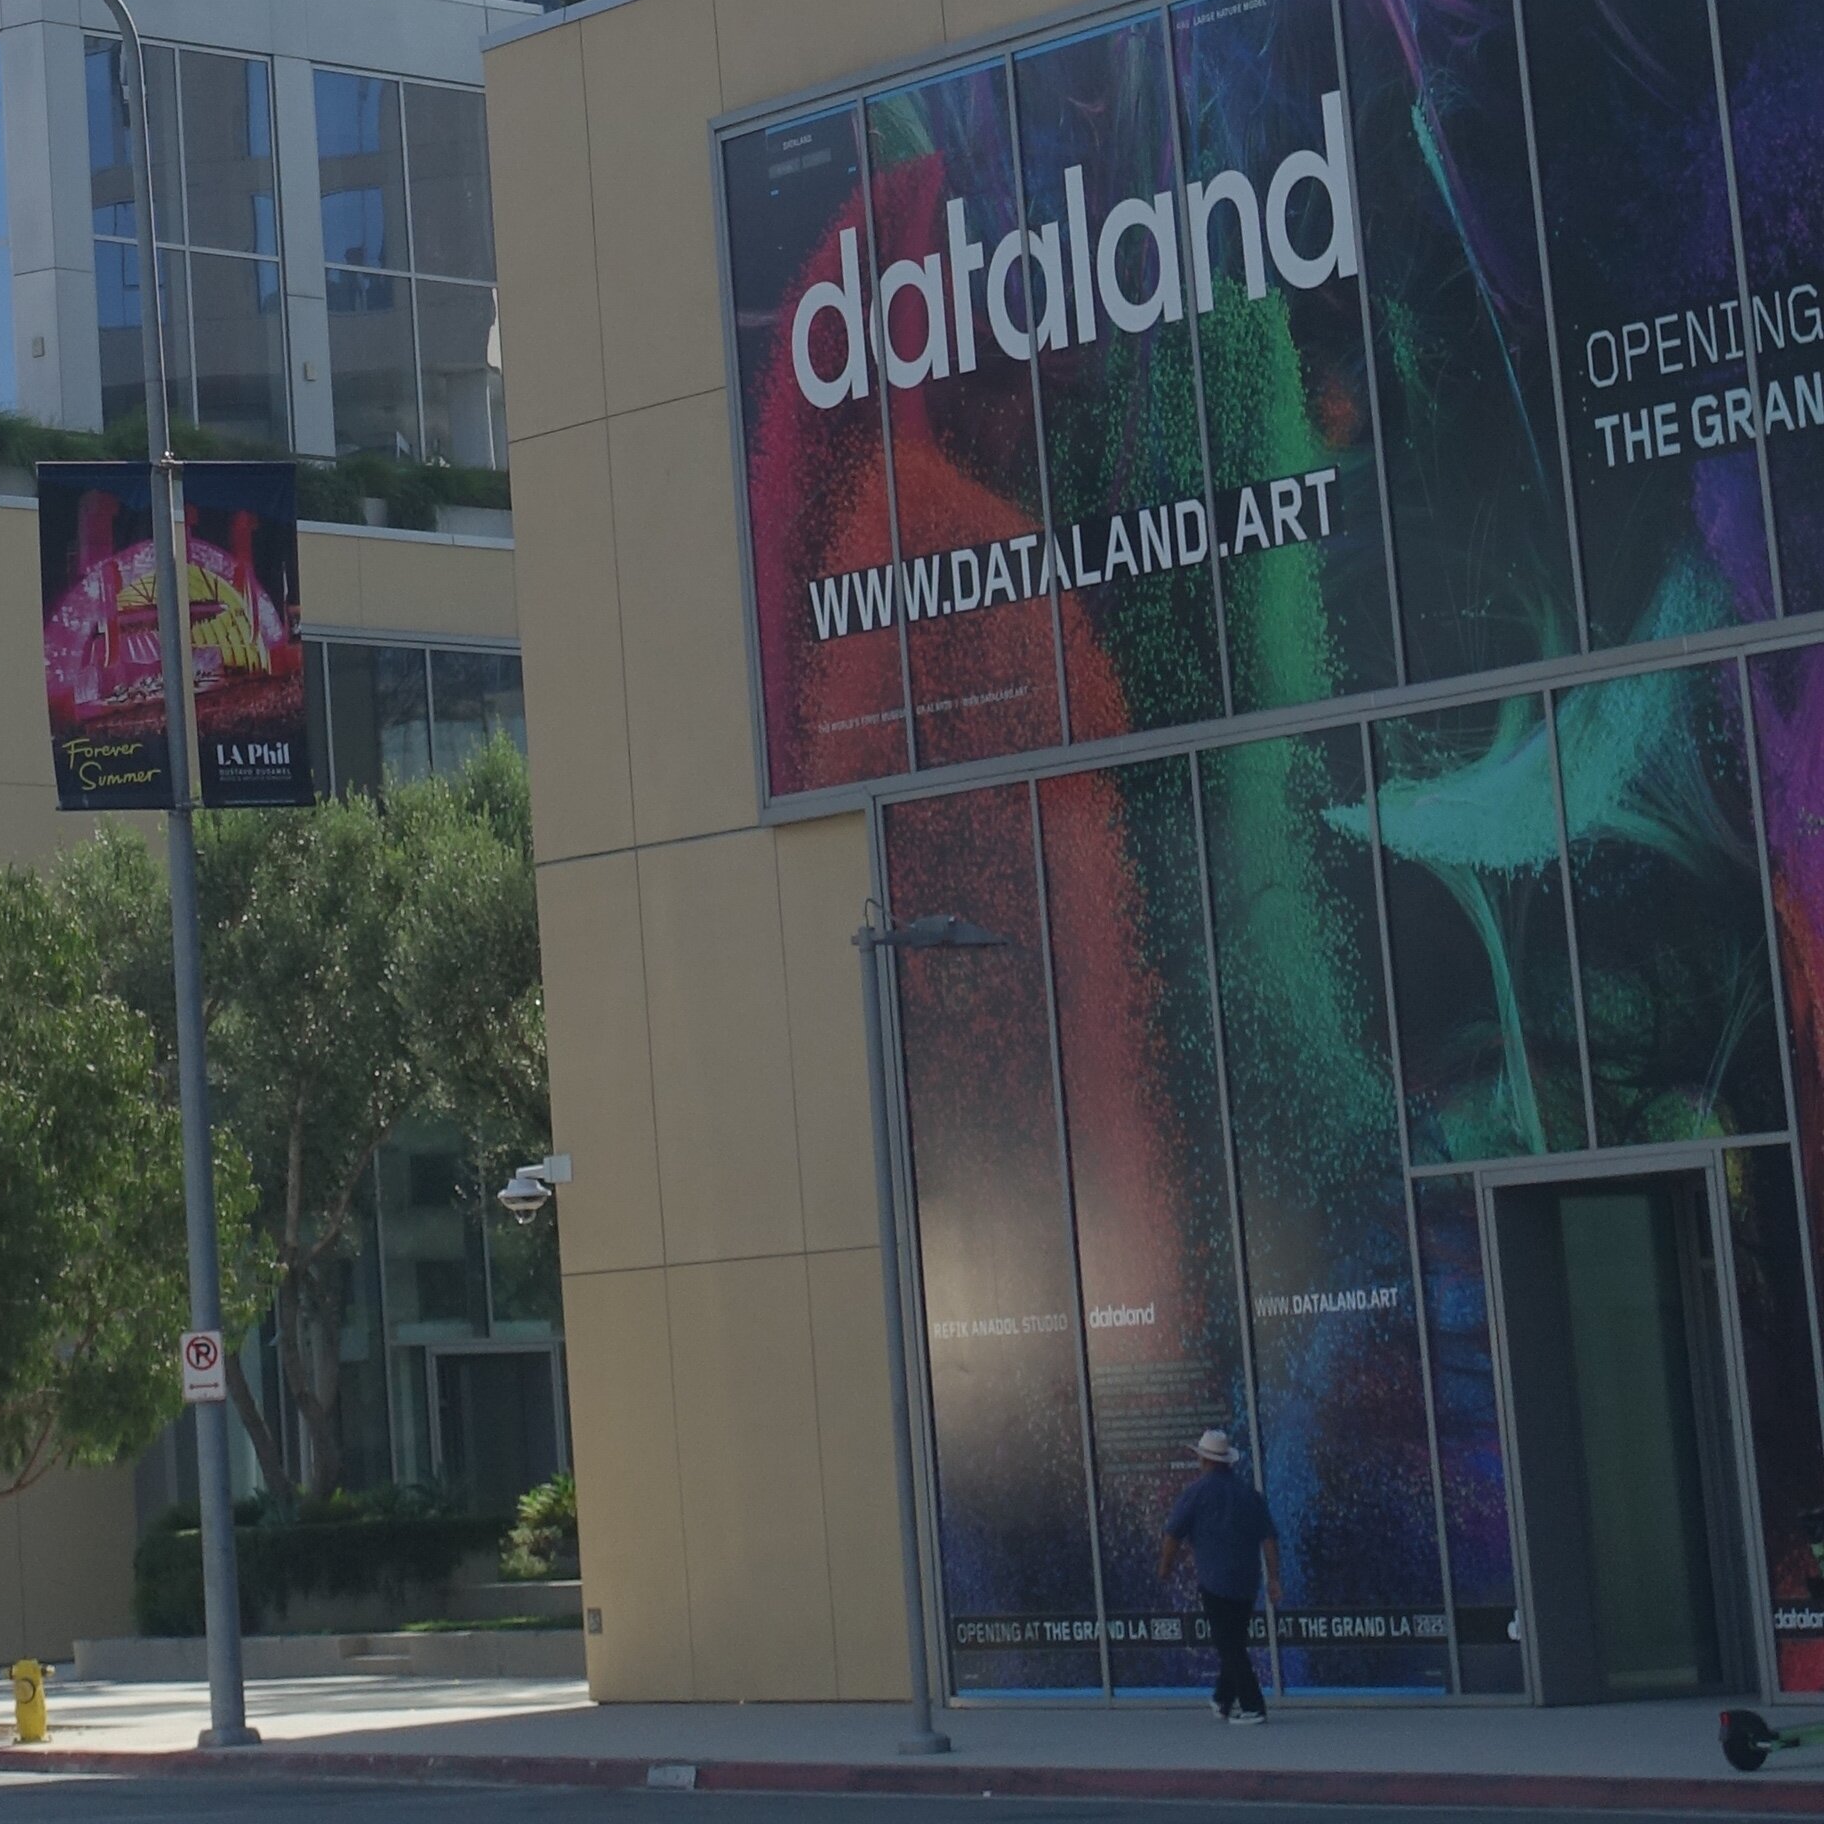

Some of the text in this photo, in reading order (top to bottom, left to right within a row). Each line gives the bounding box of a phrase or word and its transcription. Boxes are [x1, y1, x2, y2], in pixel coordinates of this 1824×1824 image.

[792, 90, 1358, 409] dataland
[1586, 284, 1824, 388] OPENING
[1594, 402, 1681, 468] THE
[808, 468, 1337, 641] WWW.DATALAND.ART
[62, 738, 142, 769] Forever
[216, 742, 290, 766] LA Phil
[79, 762, 161, 790] Summer
[934, 1313, 1069, 1339] REFIK ANADOL STUDIO
[1089, 1302, 1155, 1329] dataland
[956, 1621, 1021, 1643] OPENING
[1024, 1622, 1040, 1641] AT
[1043, 1621, 1070, 1641] THE
[1072, 1620, 1125, 1641] GRAND
[1128, 1619, 1149, 1640] LA
[1277, 1618, 1294, 1637] AT
[1298, 1617, 1328, 1637] THE
[1331, 1616, 1386, 1638] GRAND
[1389, 1616, 1411, 1636] LA
